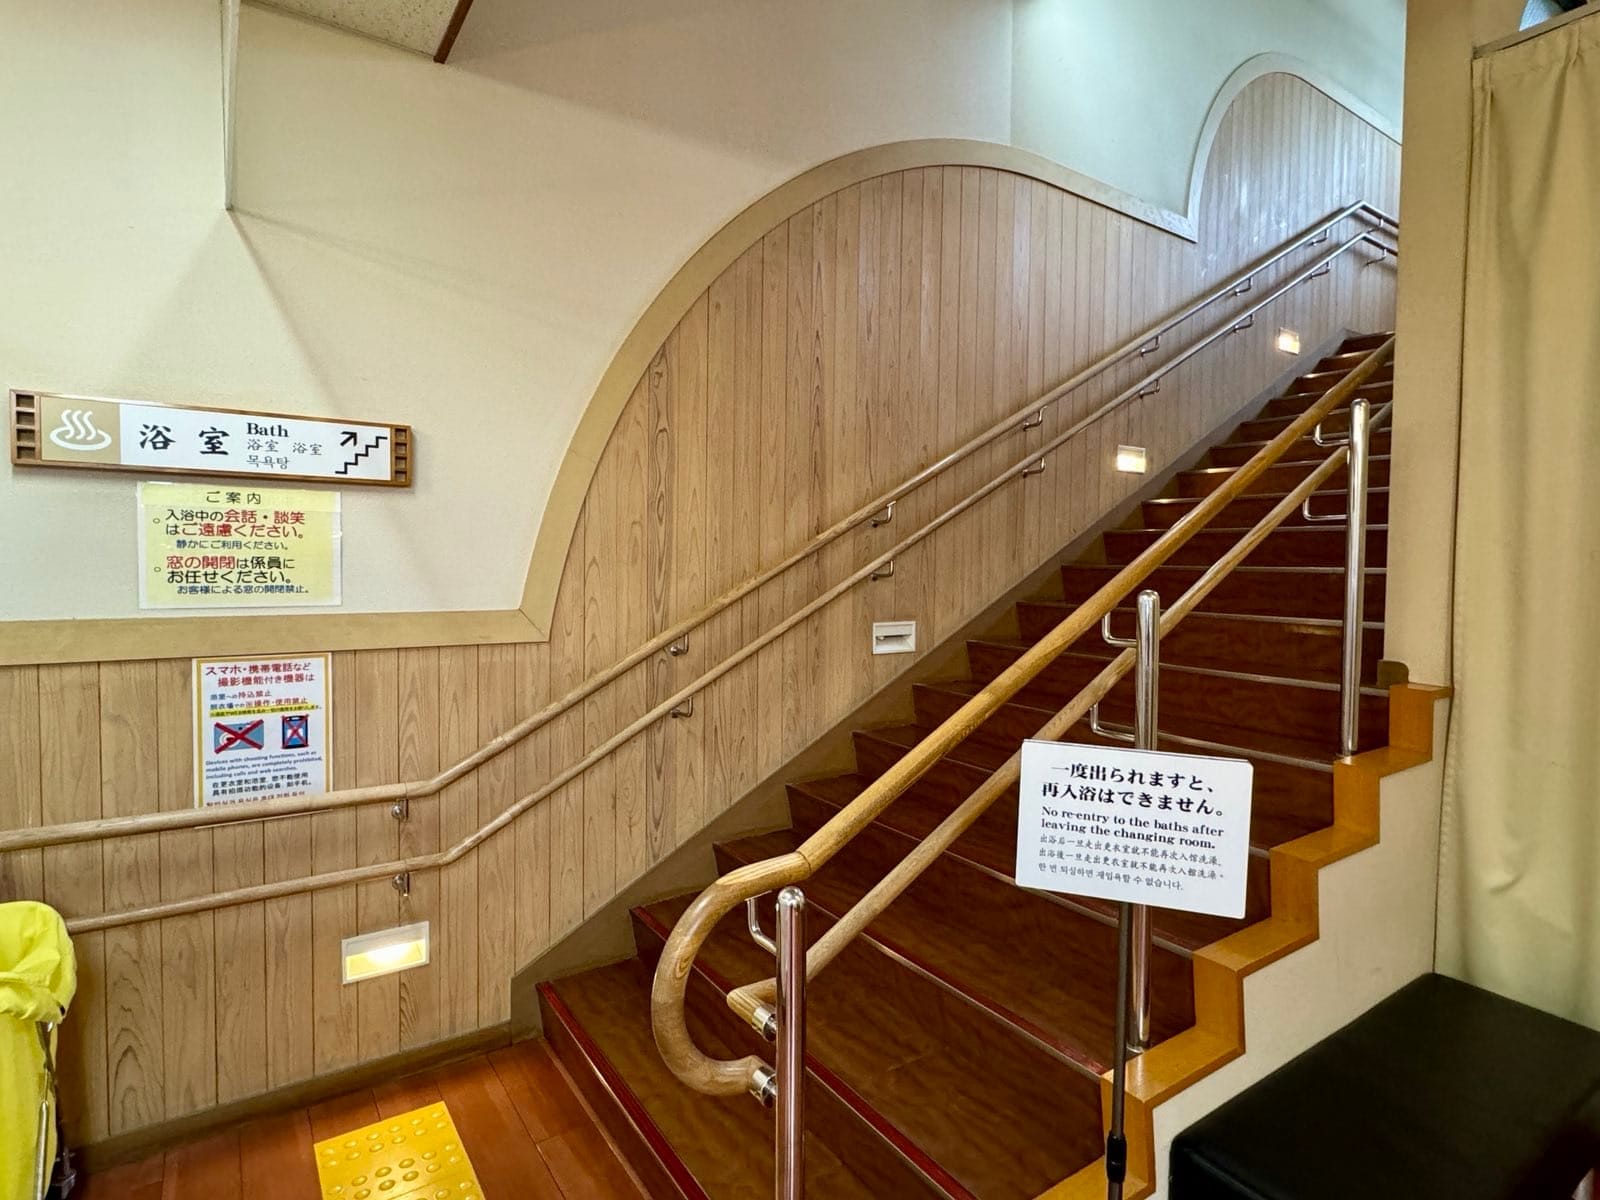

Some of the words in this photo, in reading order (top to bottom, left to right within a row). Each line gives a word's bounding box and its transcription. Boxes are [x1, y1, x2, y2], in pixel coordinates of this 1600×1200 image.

[246, 422, 289, 438] Bath
[139, 424, 230, 456] 浴室
[247, 438, 279, 453] 浴室
[292, 442, 323, 456] 浴室
[246, 455, 291, 470] 목욕탕
[206, 491, 262, 505] ご案内
[165, 508, 305, 525] 入浴中の会話・談笑
[166, 522, 304, 539] はご遠慮ください。
[176, 539, 289, 551] 静かにご利用ください。
[166, 555, 295, 570] 窓の開閉は係員に
[167, 570, 291, 584] お任せください。
[177, 585, 309, 594] お客様による窓の開閉禁止。
[205, 662, 311, 676] スマホ・携帯電話など
[217, 673, 315, 688] 撮影機能付き機器は
[1052, 763, 1214, 793] 一度出られますと、
[1041, 782, 1224, 817] 再入浴はできません。
[1041, 806, 1058, 817] No
[1061, 810, 1110, 825] re-entry
[1113, 814, 1126, 825] to
[1129, 816, 1150, 828] the
[1154, 819, 1189, 833] baths
[1192, 822, 1225, 837] after
[1041, 818, 1086, 835] leaving
[1090, 825, 1110, 836] the
[1113, 828, 1174, 846] changing
[1179, 838, 1216, 849] room.
